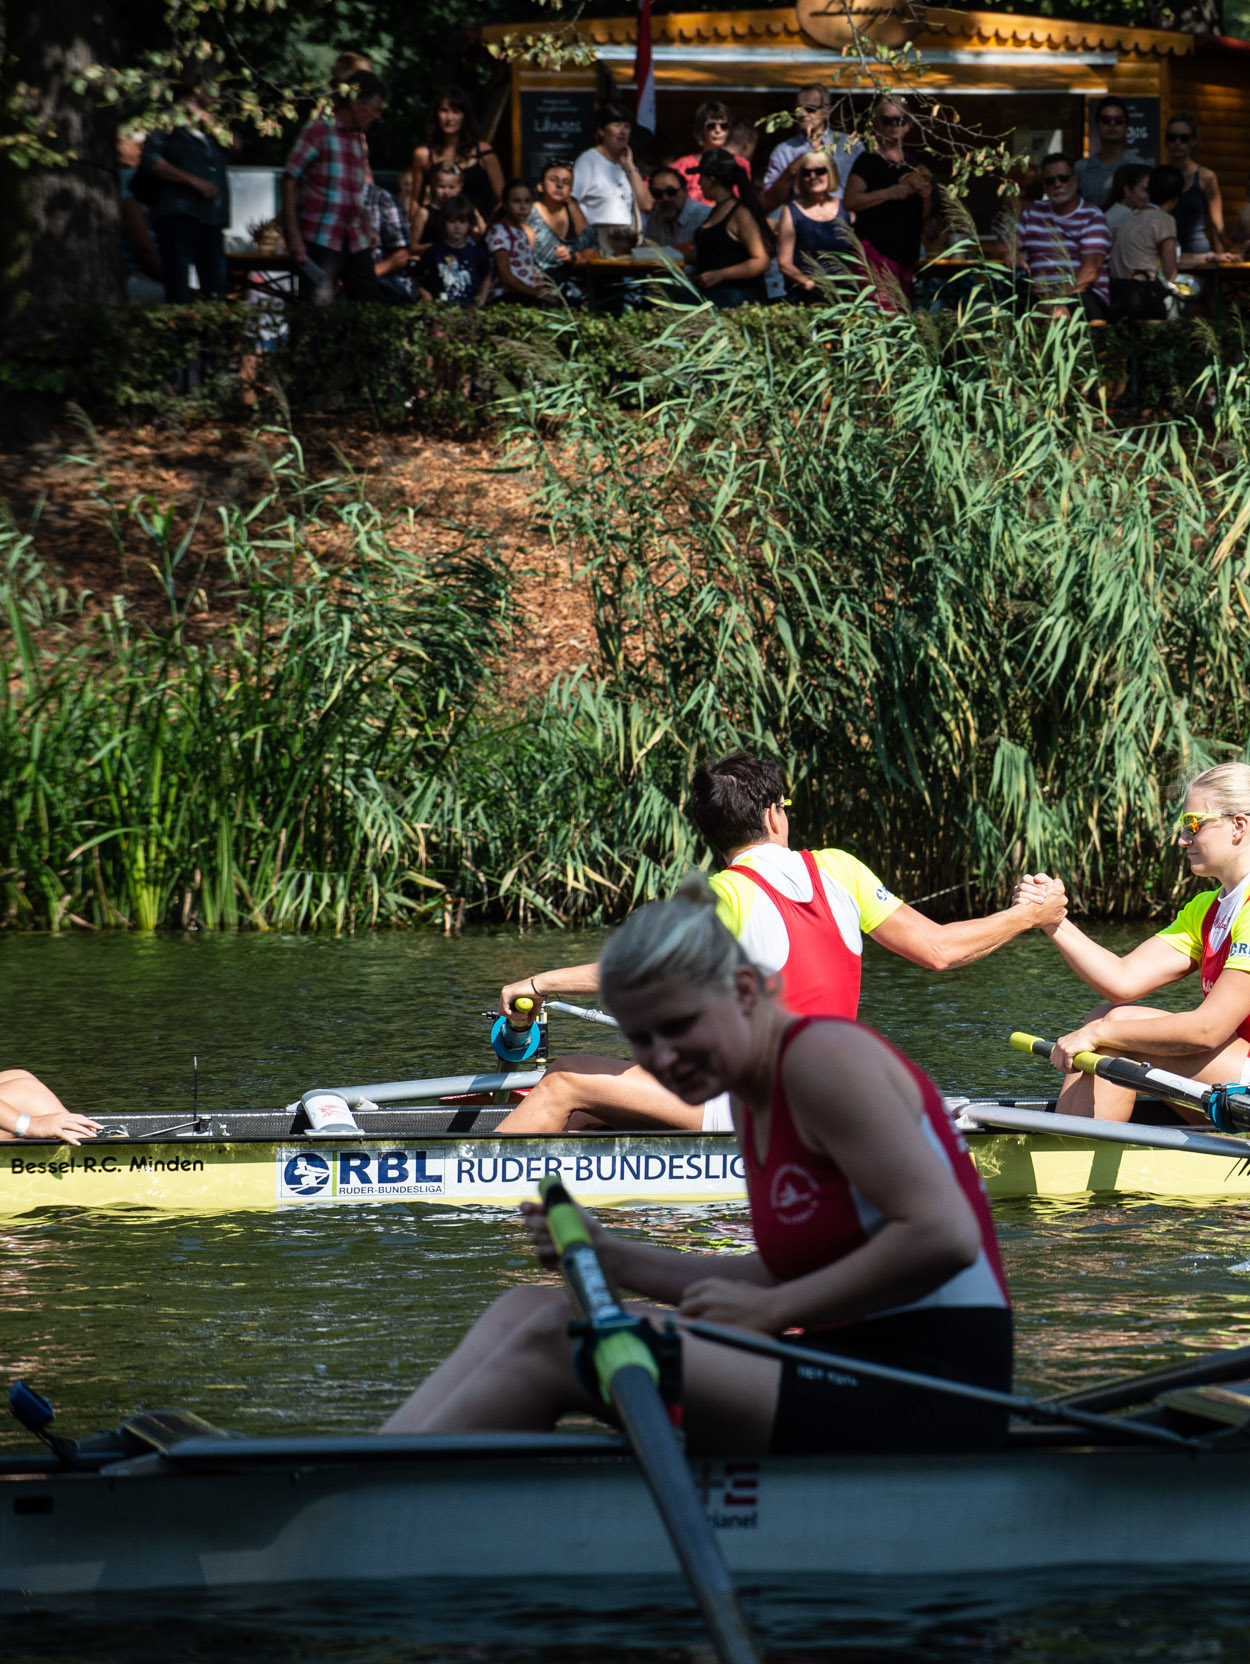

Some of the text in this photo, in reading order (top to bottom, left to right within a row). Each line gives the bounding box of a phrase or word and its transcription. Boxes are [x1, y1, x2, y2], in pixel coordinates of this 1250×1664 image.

[11, 1155, 204, 1174] Bessel-R.C. Minden
[339, 1150, 443, 1185] RBL
[456, 1154, 747, 1184] RUDER-BUNDESLIG
[339, 1185, 443, 1195] RUDER-BUNDESLIGA
